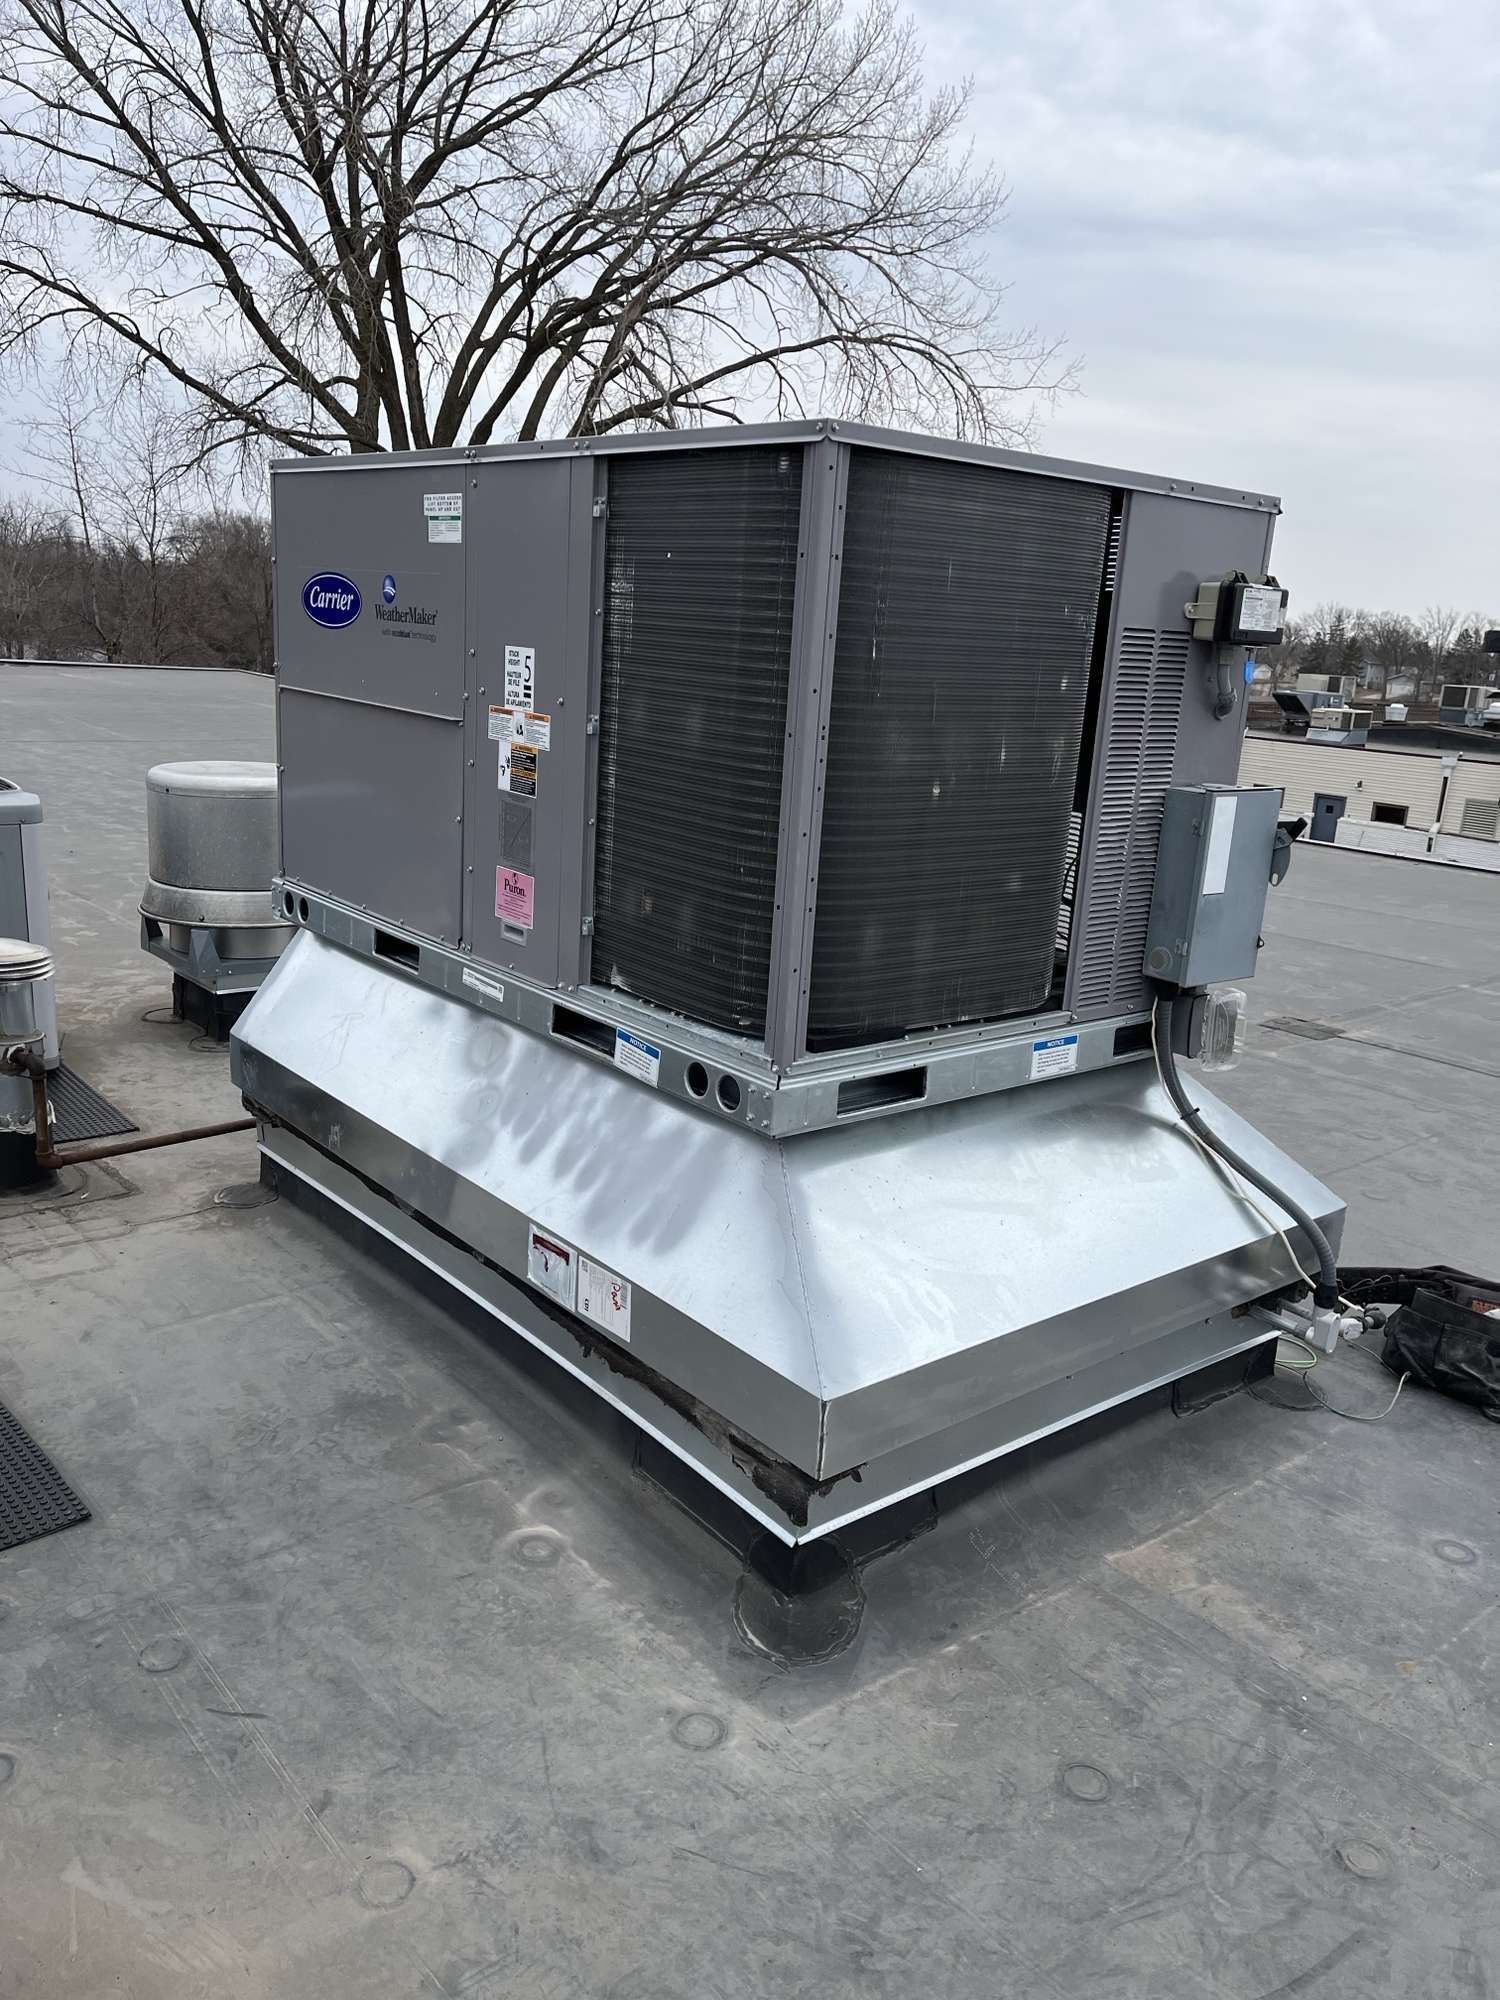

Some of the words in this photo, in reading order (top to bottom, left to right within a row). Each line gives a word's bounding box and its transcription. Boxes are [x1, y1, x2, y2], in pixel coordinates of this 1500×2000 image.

[310, 585, 354, 611] Carrier
[375, 604, 438, 625] WeatherMaker
[524, 655, 531, 683] 5
[504, 879, 525, 896] Puron
[629, 1037, 647, 1051] NOTICE
